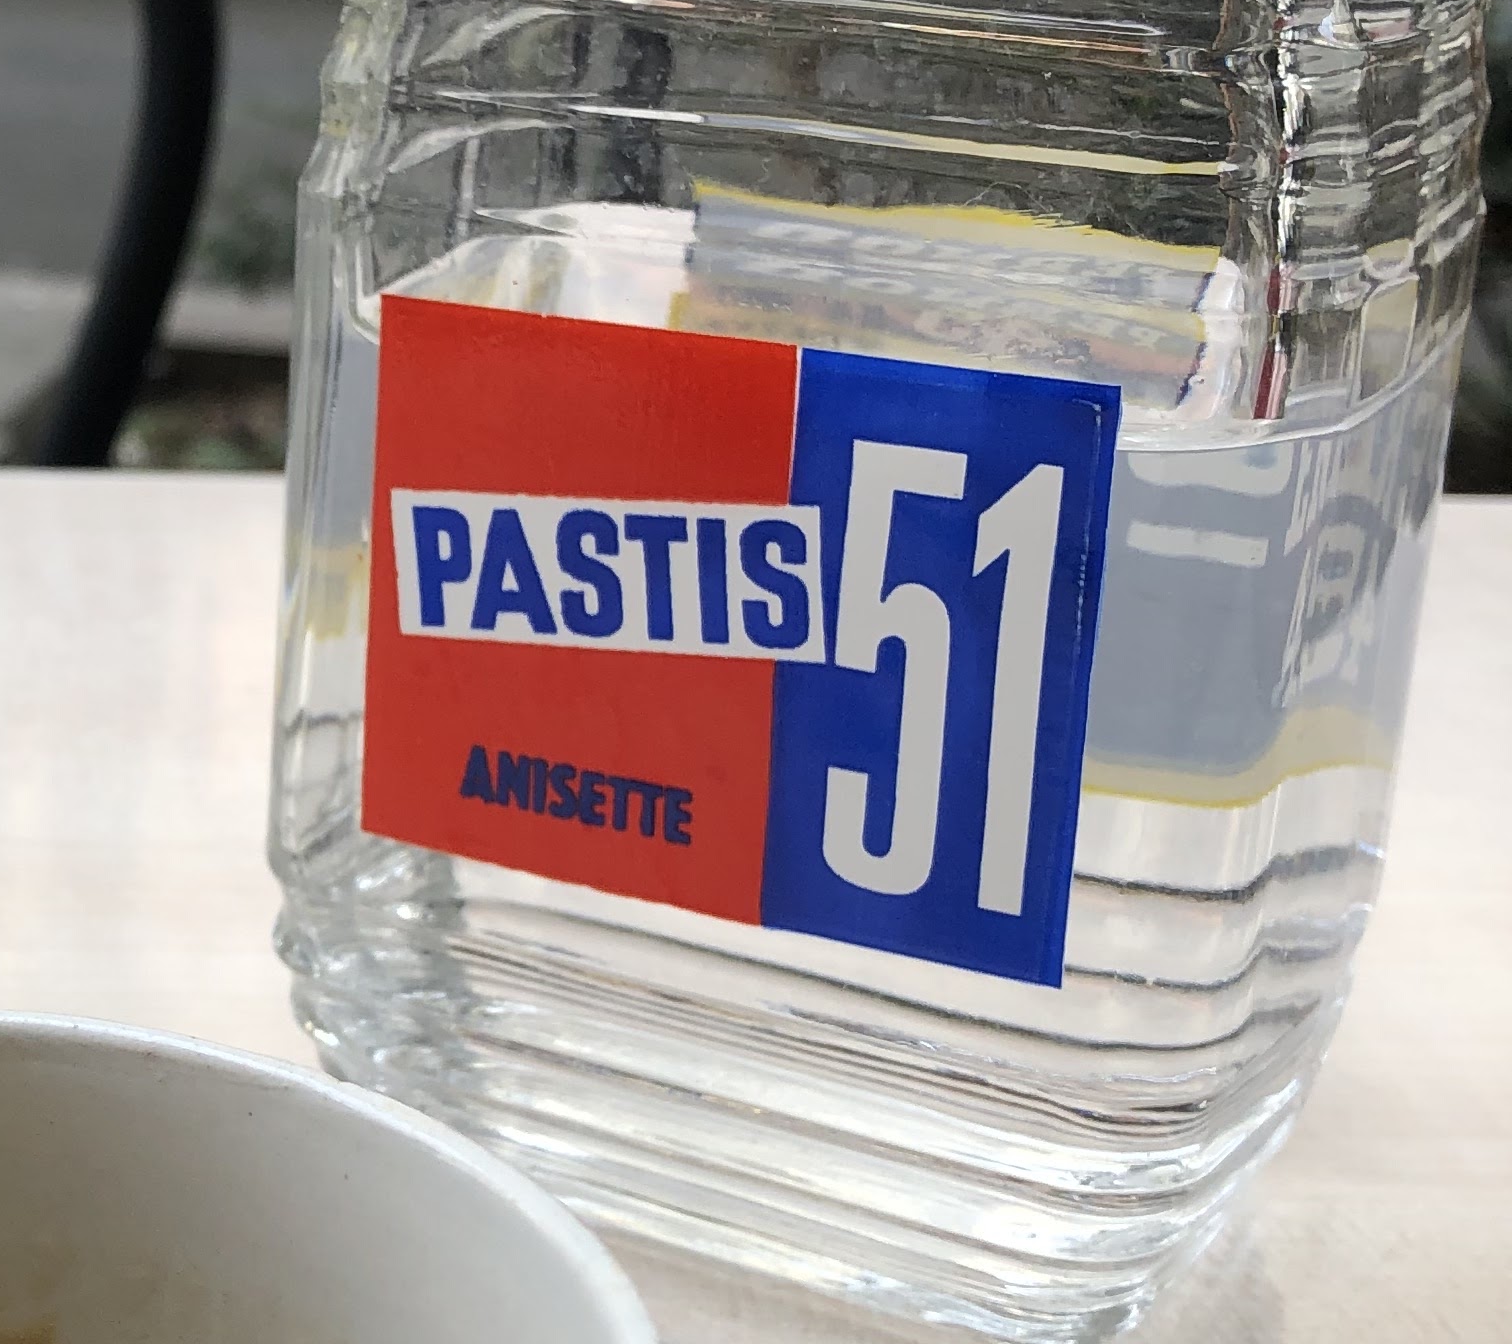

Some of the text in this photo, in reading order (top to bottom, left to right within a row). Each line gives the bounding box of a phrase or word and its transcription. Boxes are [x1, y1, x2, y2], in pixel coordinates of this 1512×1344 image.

[412, 438, 1065, 917] PASTIS 51
[459, 744, 693, 845] ANISETTE
